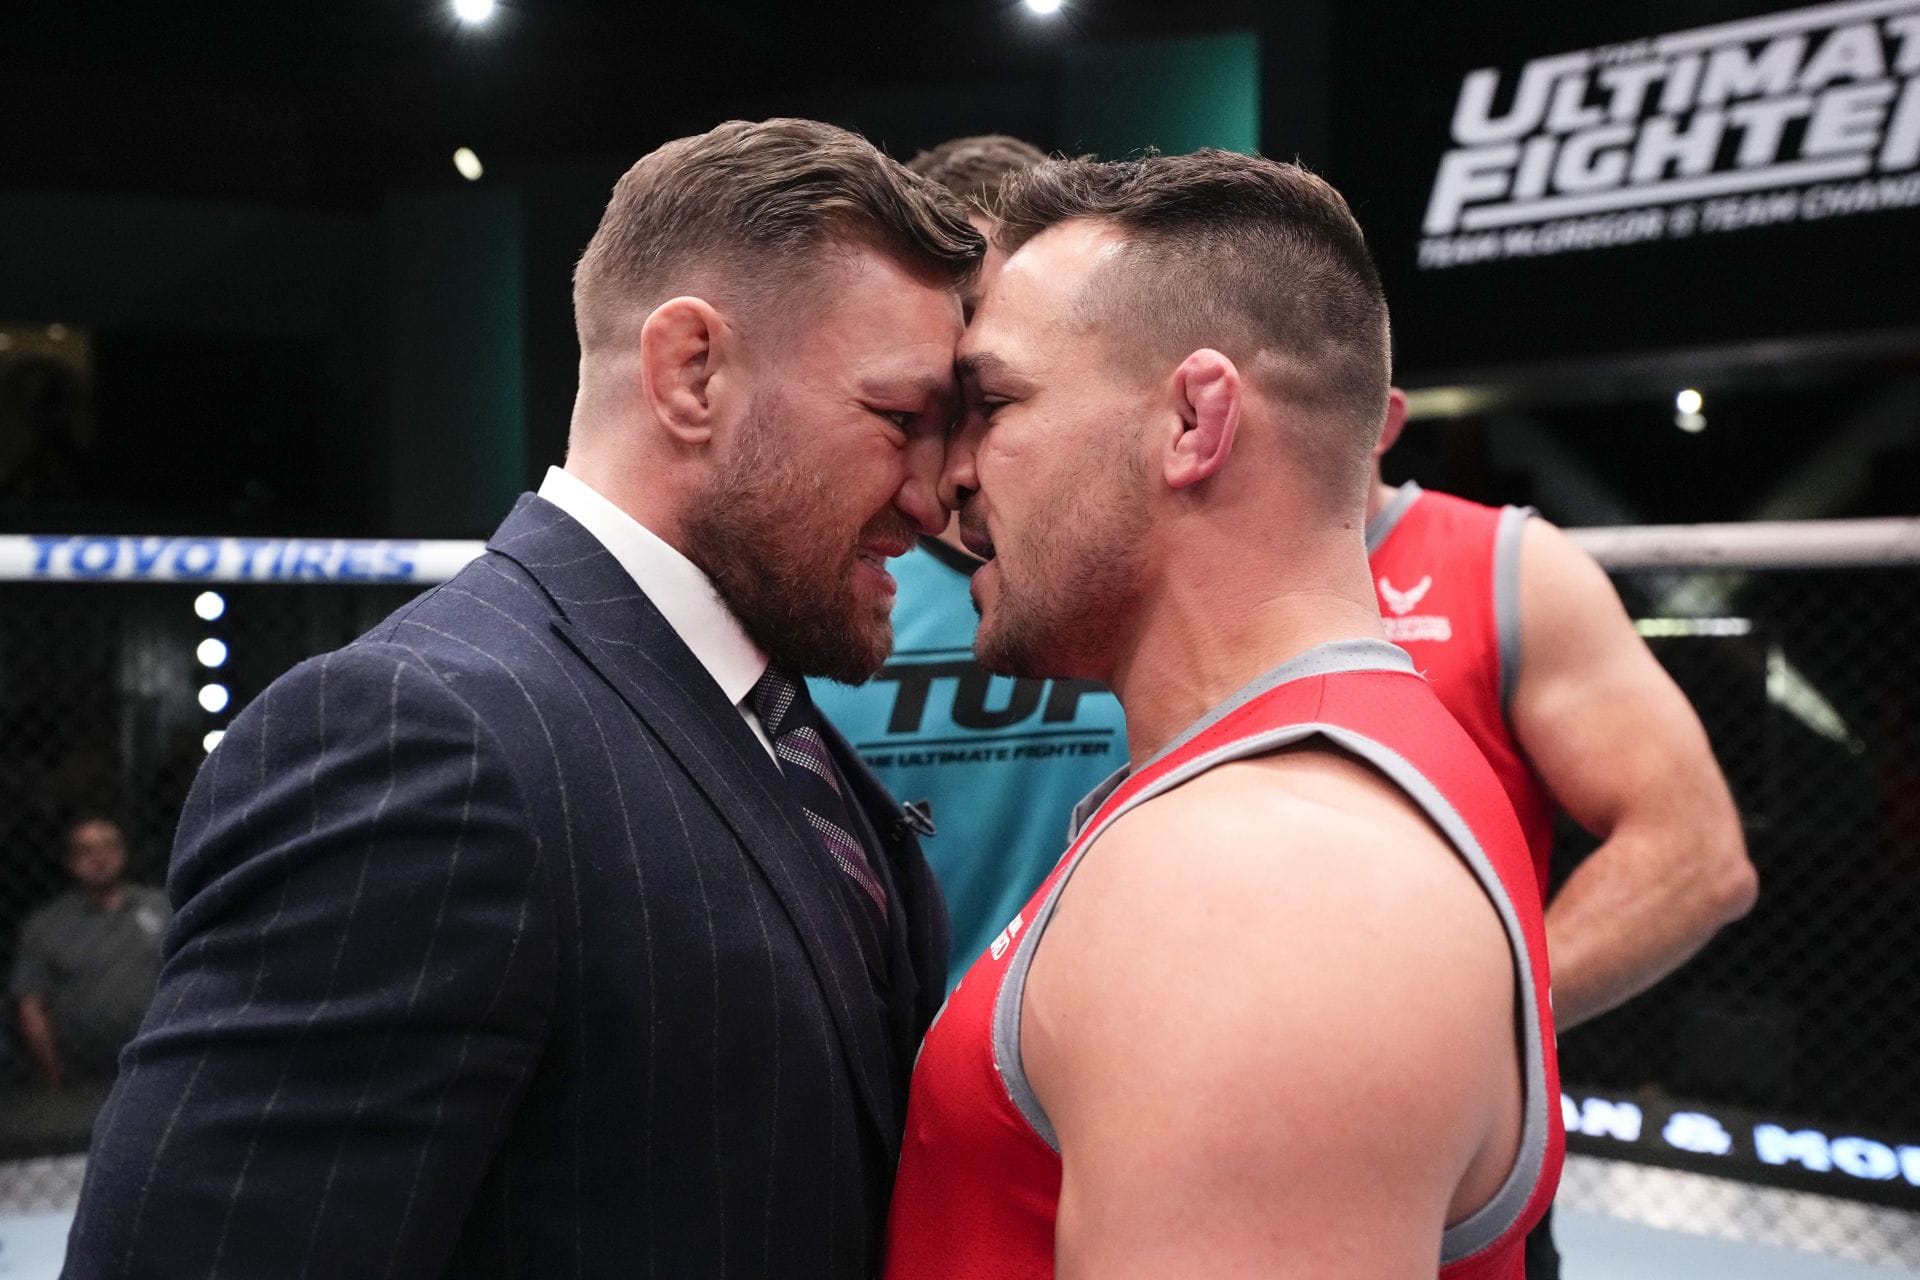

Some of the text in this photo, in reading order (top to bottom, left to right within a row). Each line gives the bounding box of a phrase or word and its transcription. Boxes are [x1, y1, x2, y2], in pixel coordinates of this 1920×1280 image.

[1417, 232, 1499, 269] TEAM
[1700, 189, 1799, 233] TEAM
[30, 537, 414, 580] TOYO TIRES
[899, 745, 1009, 768] ULTIMATE
[1013, 741, 1111, 761] FIGHTER
